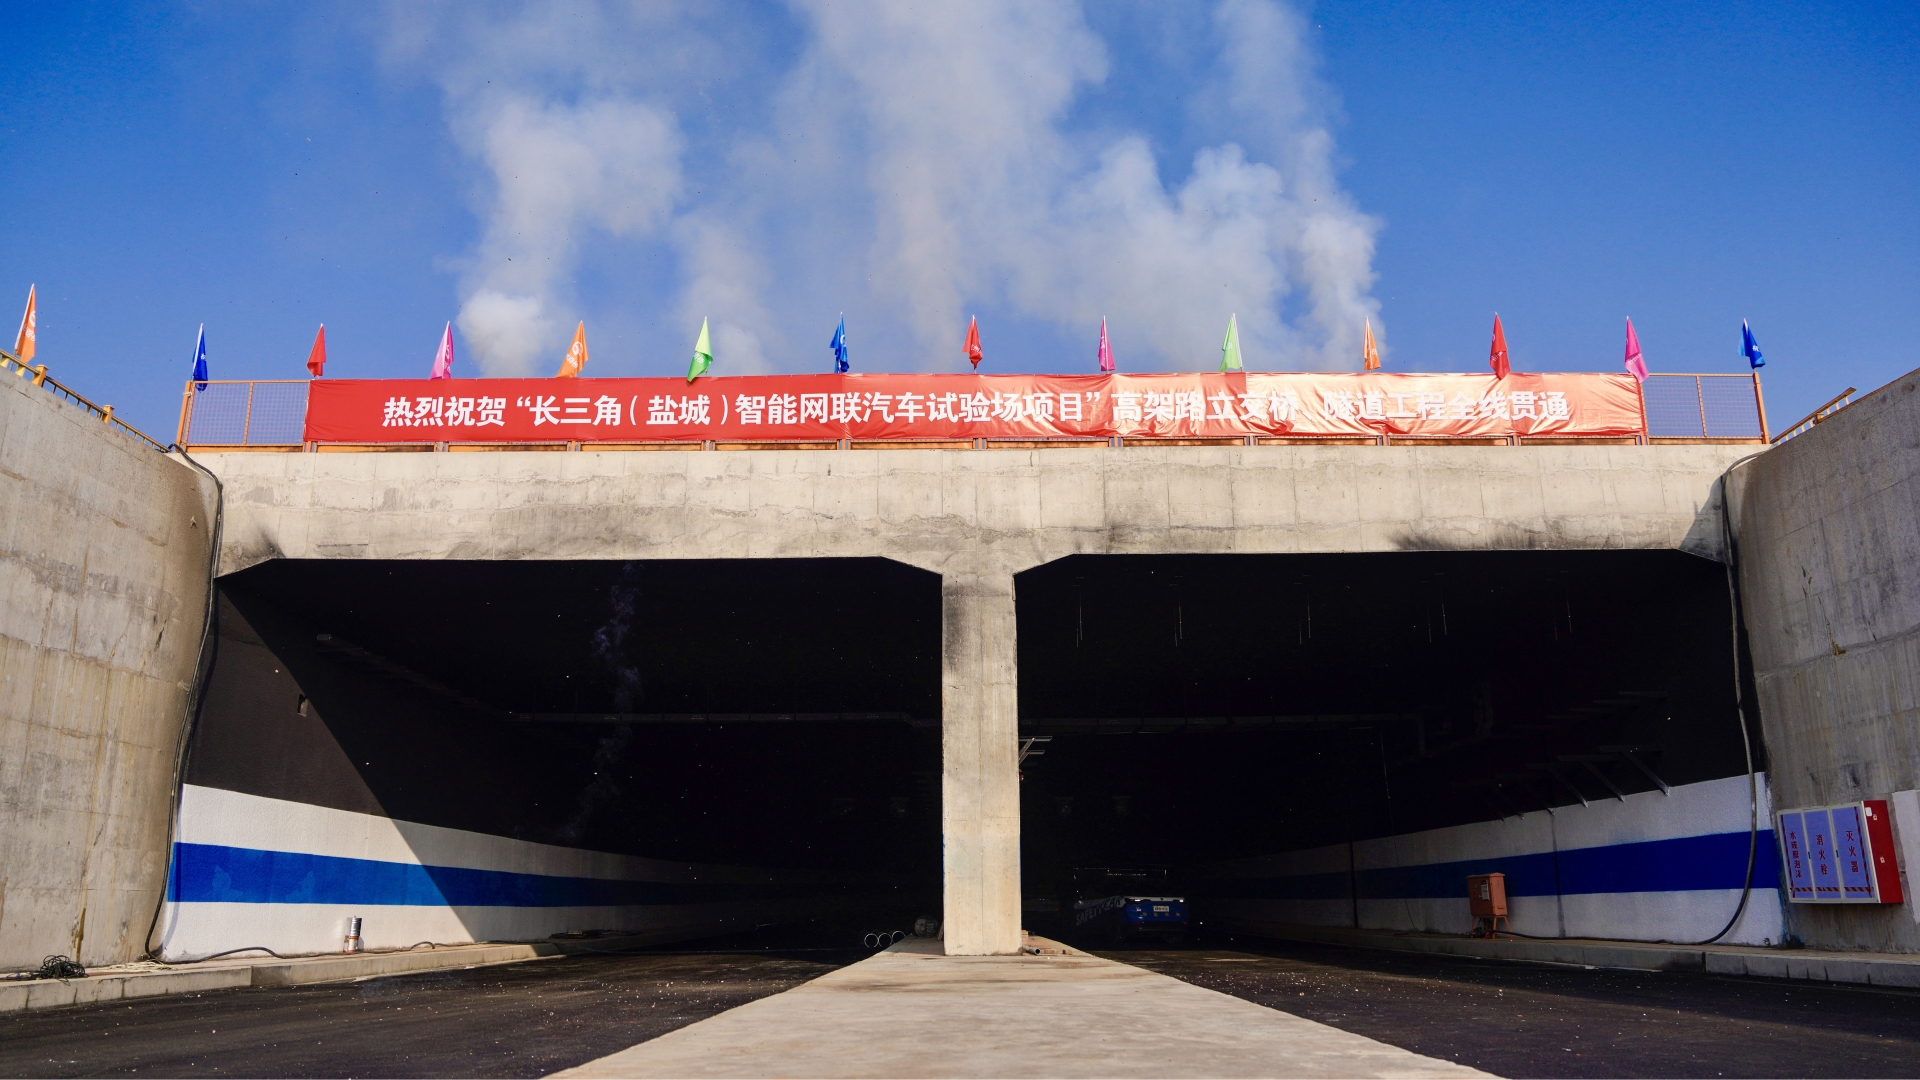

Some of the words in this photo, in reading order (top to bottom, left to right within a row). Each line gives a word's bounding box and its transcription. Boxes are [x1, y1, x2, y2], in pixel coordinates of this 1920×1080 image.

[1816, 834, 1829, 875] 消火栓
[1845, 830, 1859, 873] 灭火器
[1076, 903, 1103, 926] SAFETY
